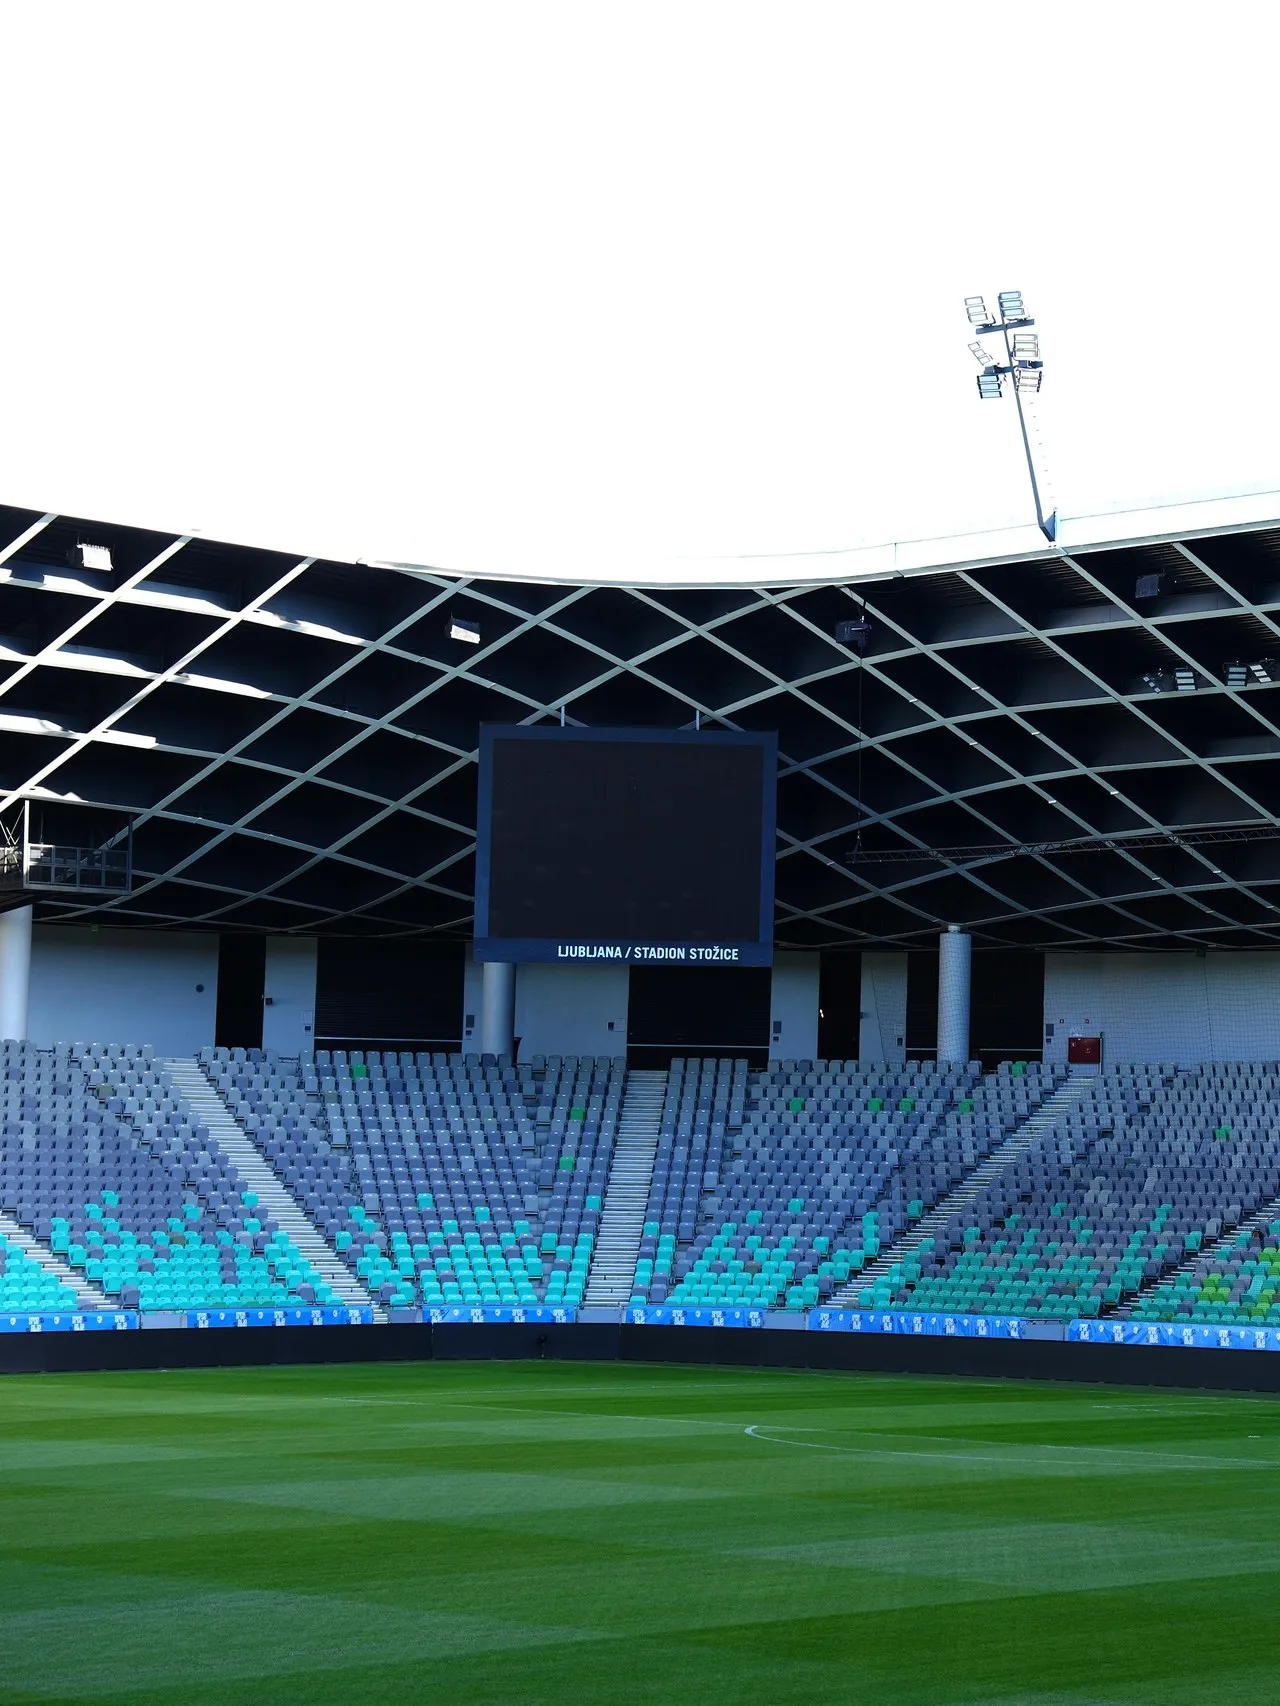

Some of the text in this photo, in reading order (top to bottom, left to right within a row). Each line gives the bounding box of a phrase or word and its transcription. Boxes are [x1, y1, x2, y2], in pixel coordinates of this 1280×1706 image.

[557, 945, 739, 961] LJUBLJANA / STADION STOŽICE
